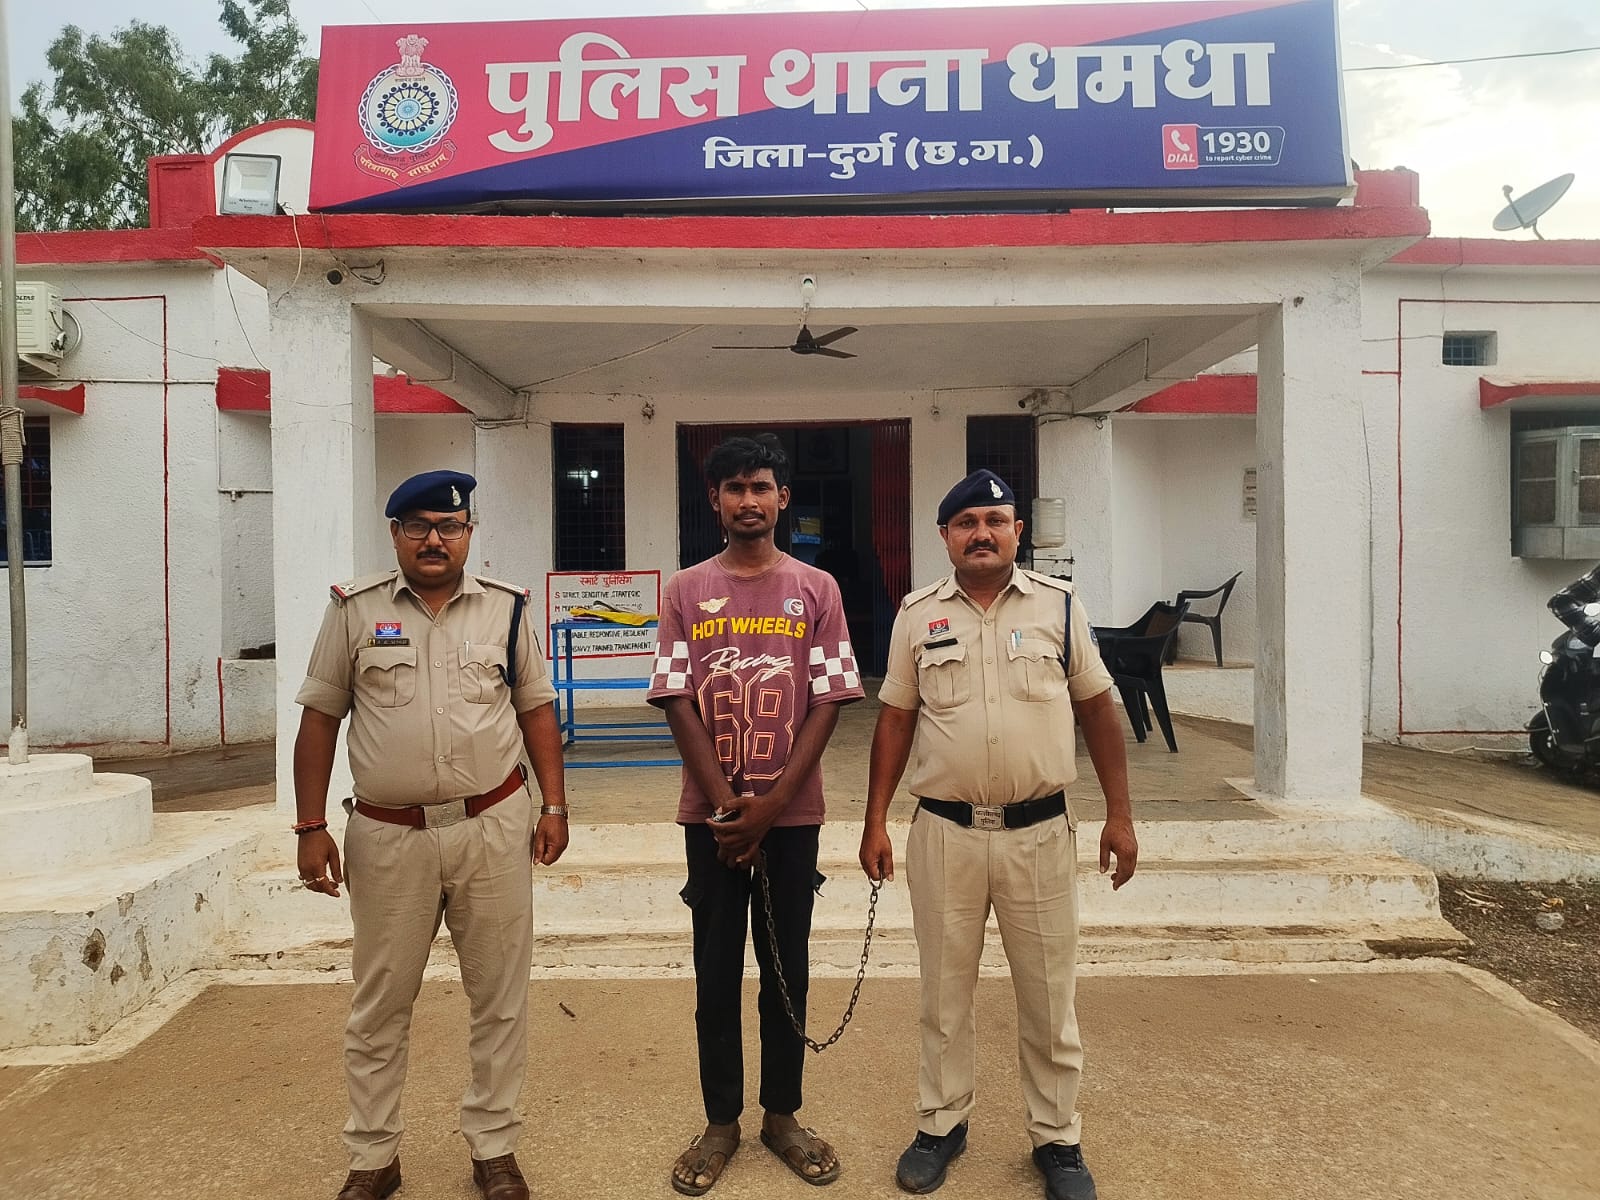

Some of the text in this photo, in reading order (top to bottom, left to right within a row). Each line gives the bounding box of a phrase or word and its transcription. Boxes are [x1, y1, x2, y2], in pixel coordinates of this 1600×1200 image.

[485, 31, 1276, 153] पुलिस थाना धमधा
[905, 133, 1044, 171] (छ.ग.)
[1167, 153, 1196, 163] DIAL
[1202, 131, 1271, 154] 1930
[692, 616, 807, 641] HOT WHEELS
[700, 646, 795, 683] Racing
[697, 668, 796, 781] 68
